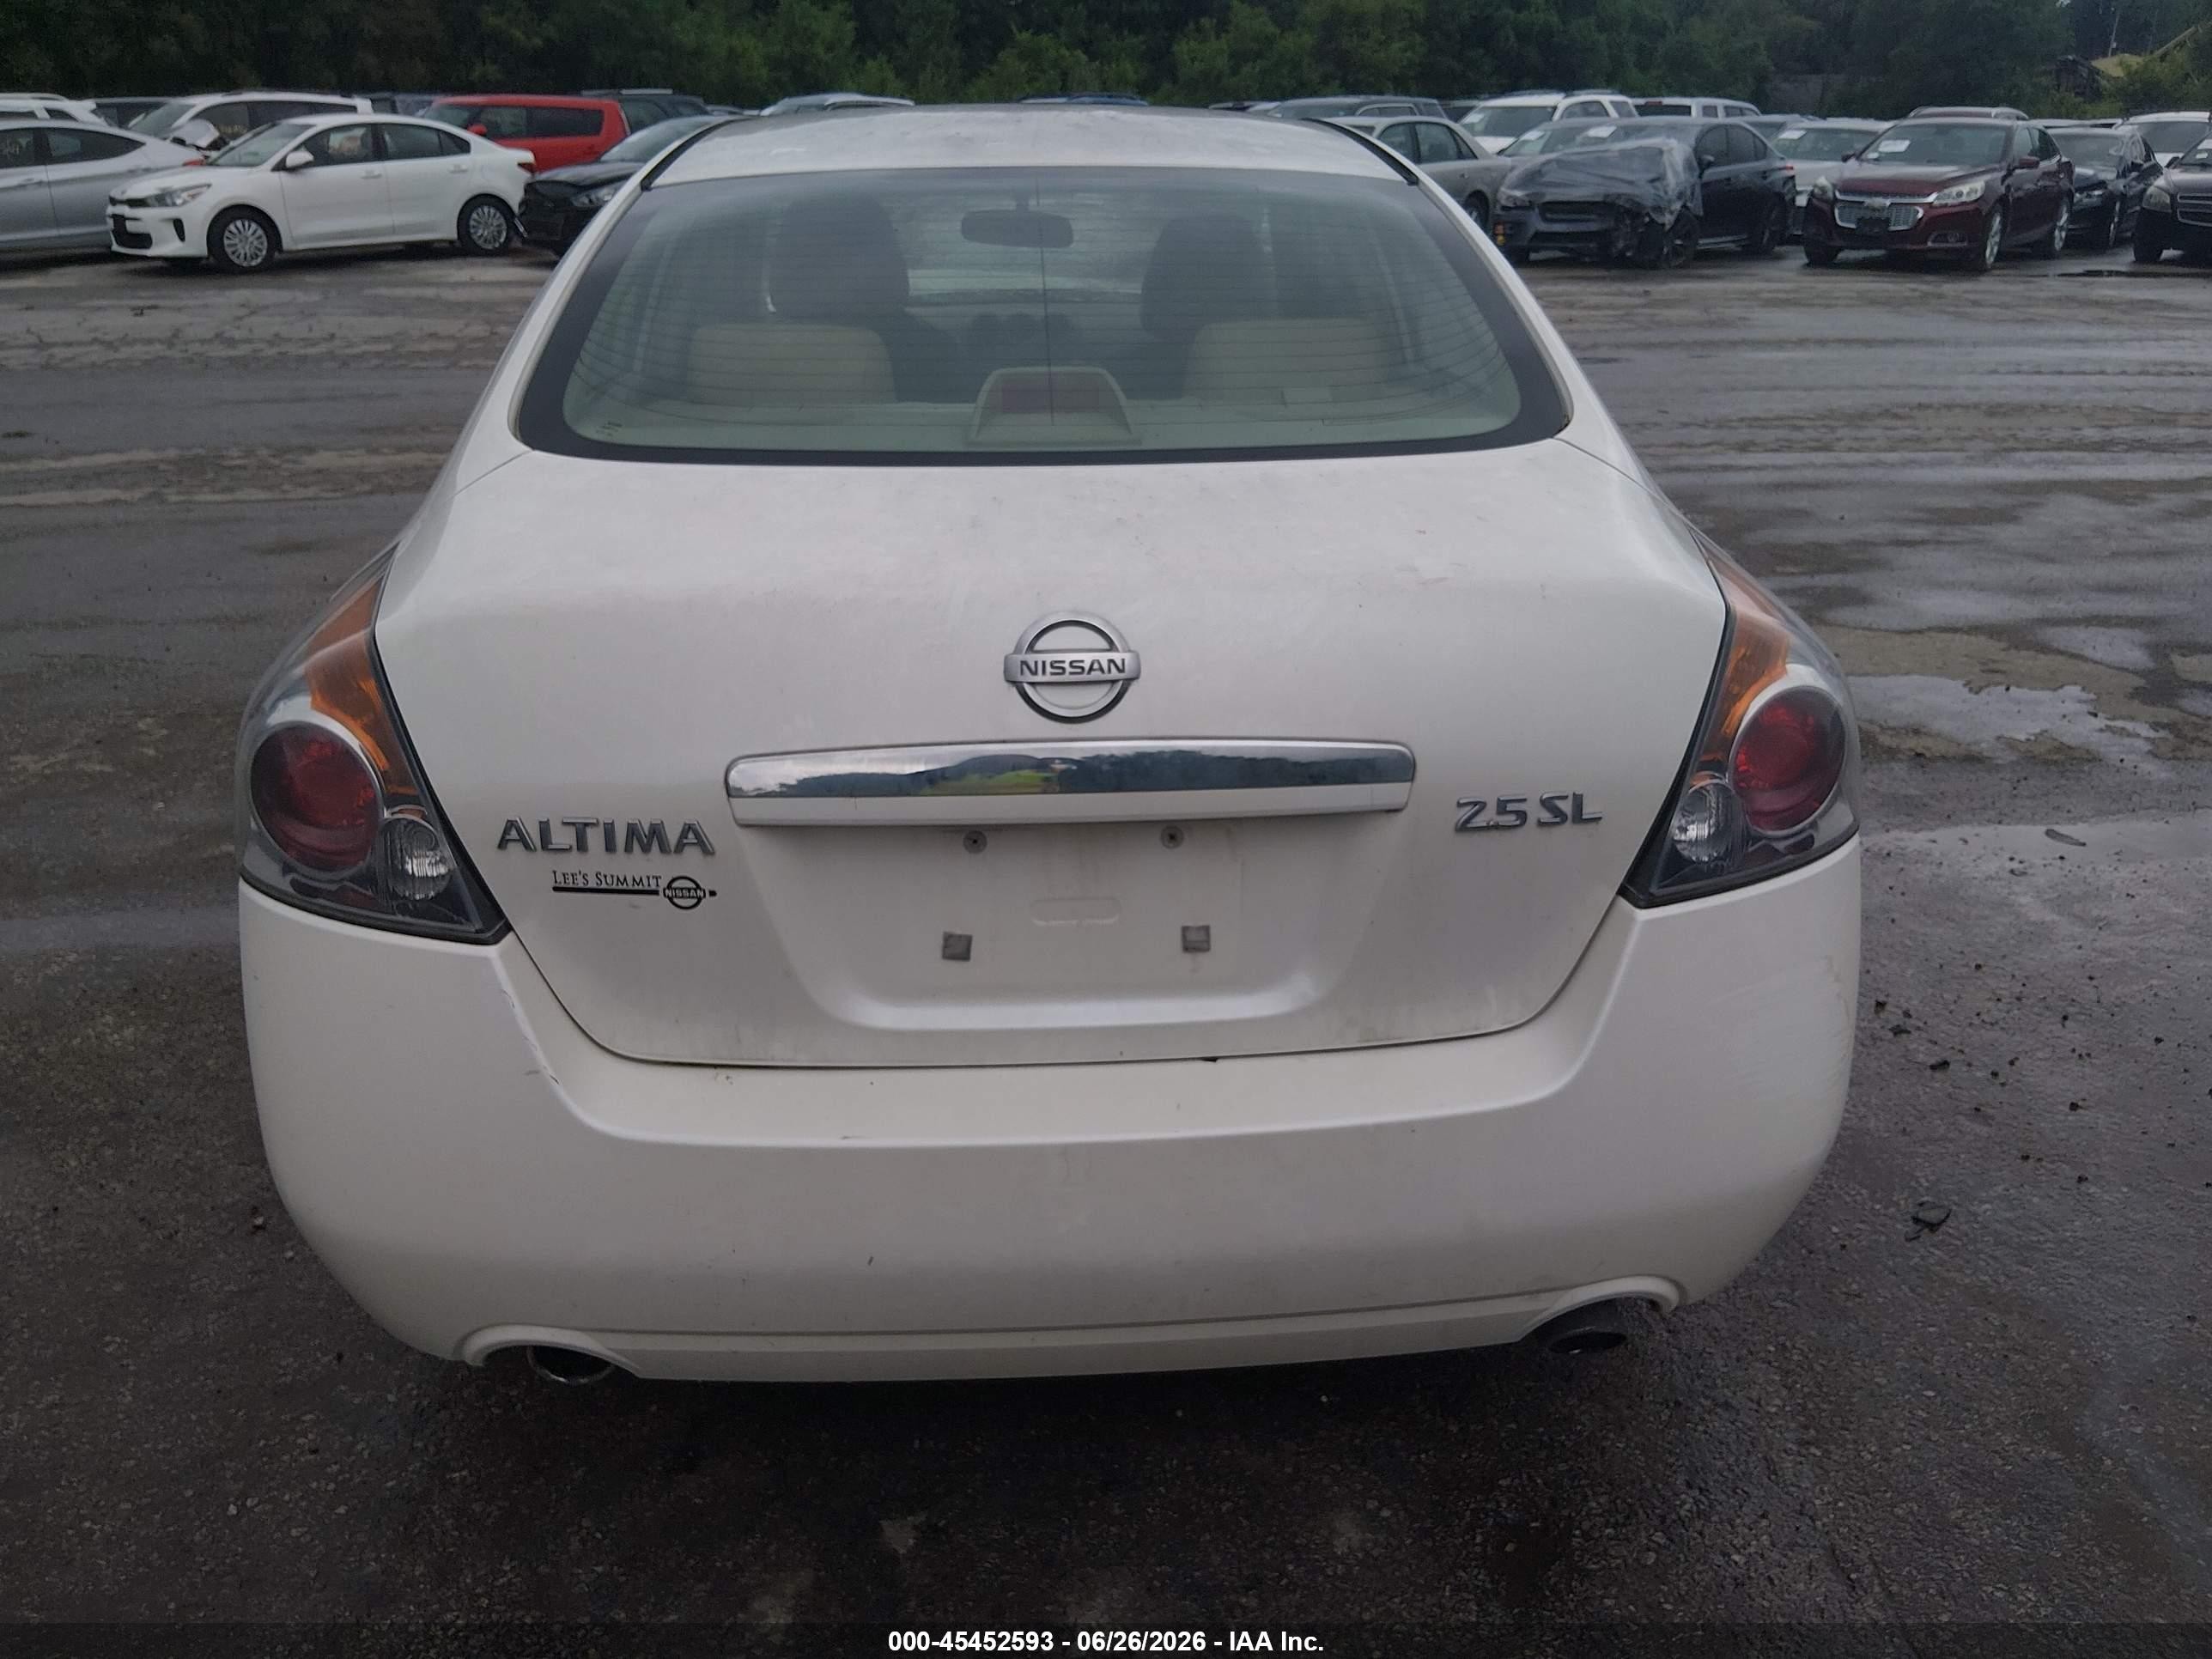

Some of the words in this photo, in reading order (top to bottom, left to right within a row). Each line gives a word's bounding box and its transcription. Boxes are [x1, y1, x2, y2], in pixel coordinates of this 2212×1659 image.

[1019, 657, 1127, 678] NISSAN
[1537, 791, 1603, 826] SL
[497, 817, 715, 855] ALTIMA
[552, 870, 590, 886] LEE'S
[595, 871, 662, 888] SUMMIT
[664, 887, 706, 900] NISSAN
